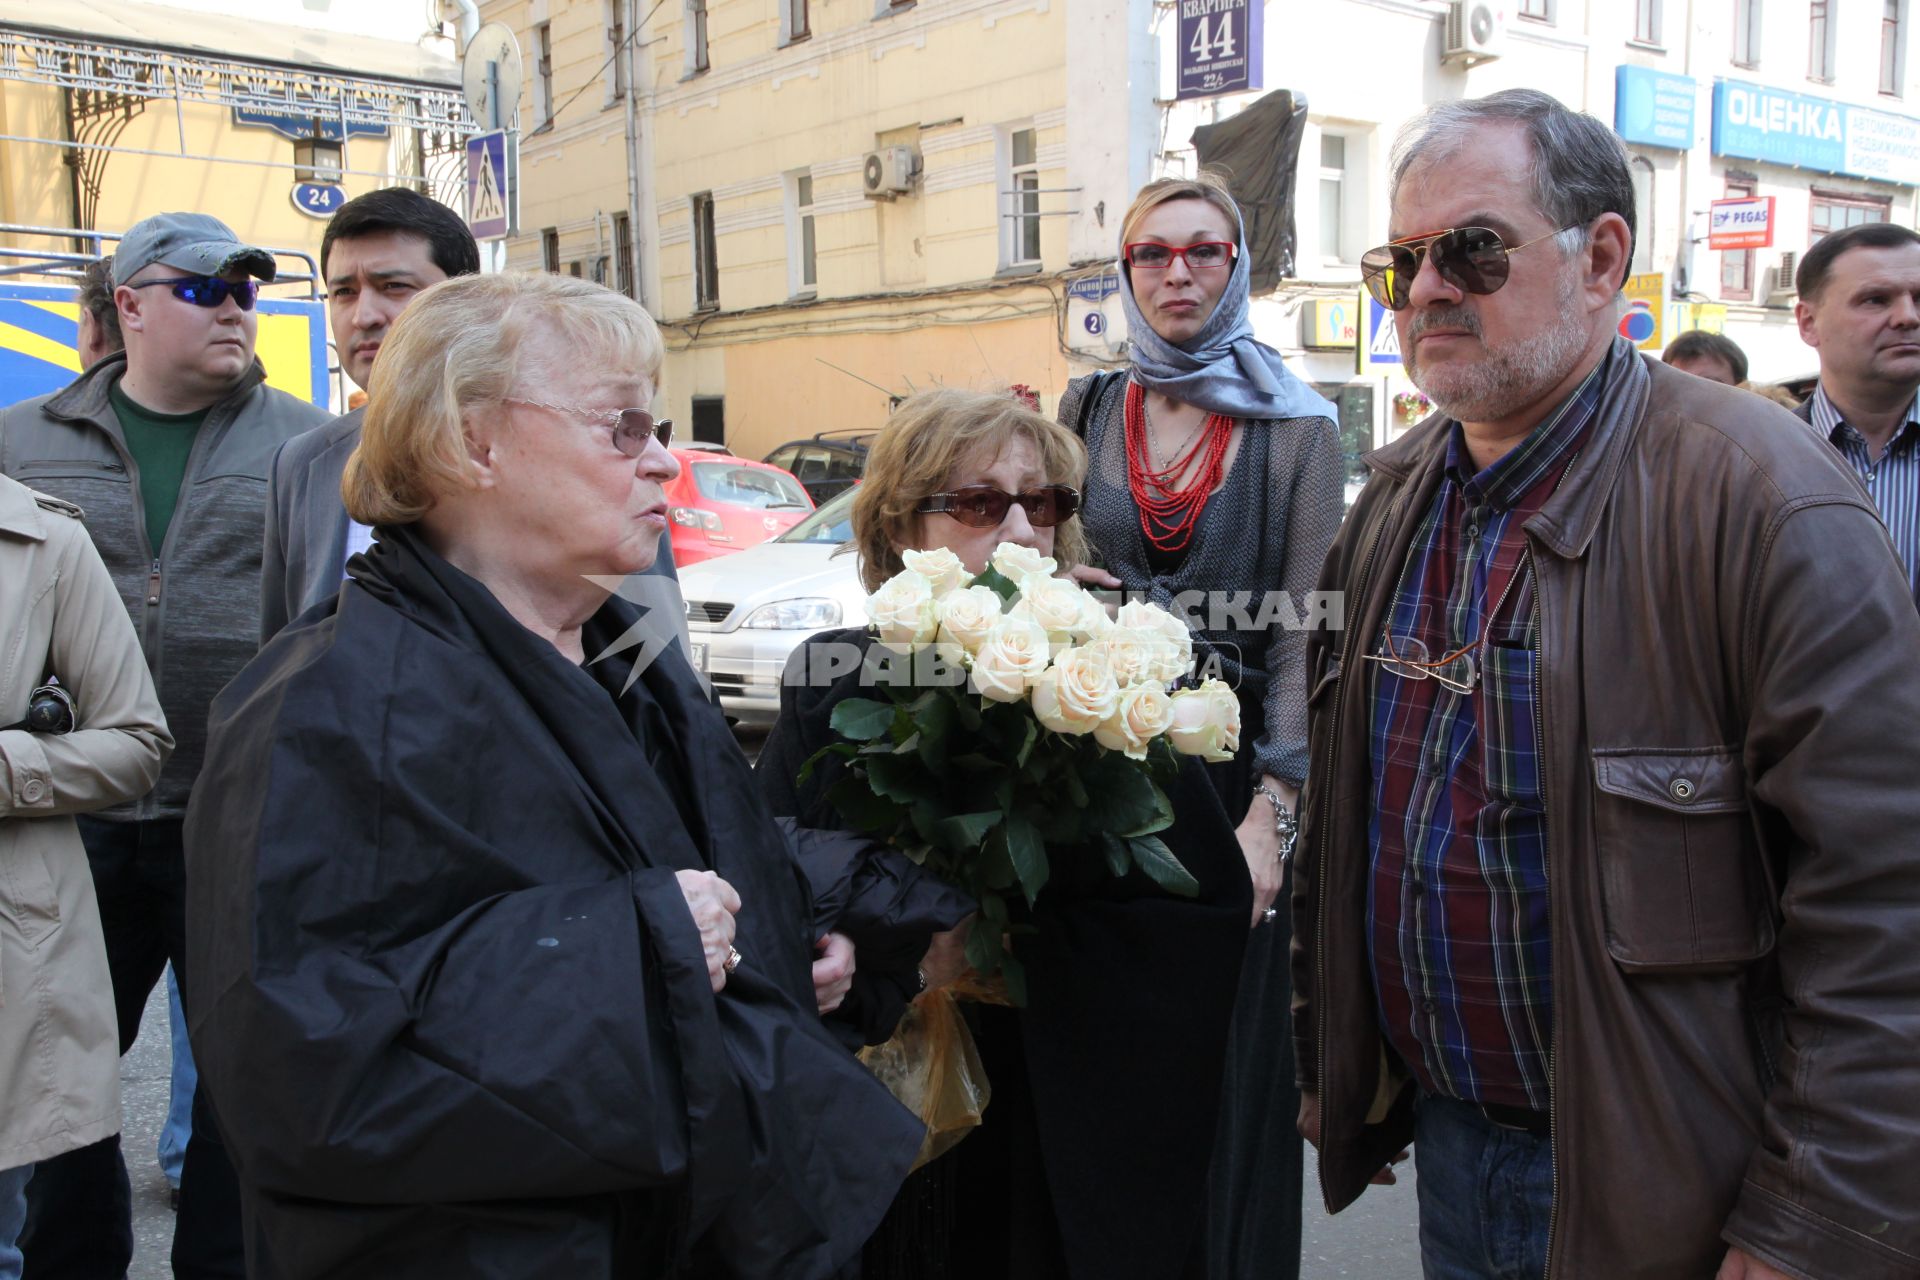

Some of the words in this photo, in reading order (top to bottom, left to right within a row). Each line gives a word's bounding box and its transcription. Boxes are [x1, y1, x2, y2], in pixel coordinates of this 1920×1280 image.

[1190, 11, 1236, 62] 44
[241, 102, 303, 119] БОЛЬША
[1728, 88, 1843, 142] ОЦЕНКА
[1853, 115, 1917, 140] АВТОМОБИЛИ
[1852, 135, 1920, 160] НЕДВИЖИМОС
[1852, 152, 1889, 174] БИЗНЕС
[309, 188, 330, 206] 24
[1734, 210, 1767, 223] PEGAS
[1069, 279, 1117, 292] ЛЫНОВКИЙ
[1090, 315, 1098, 331] 2
